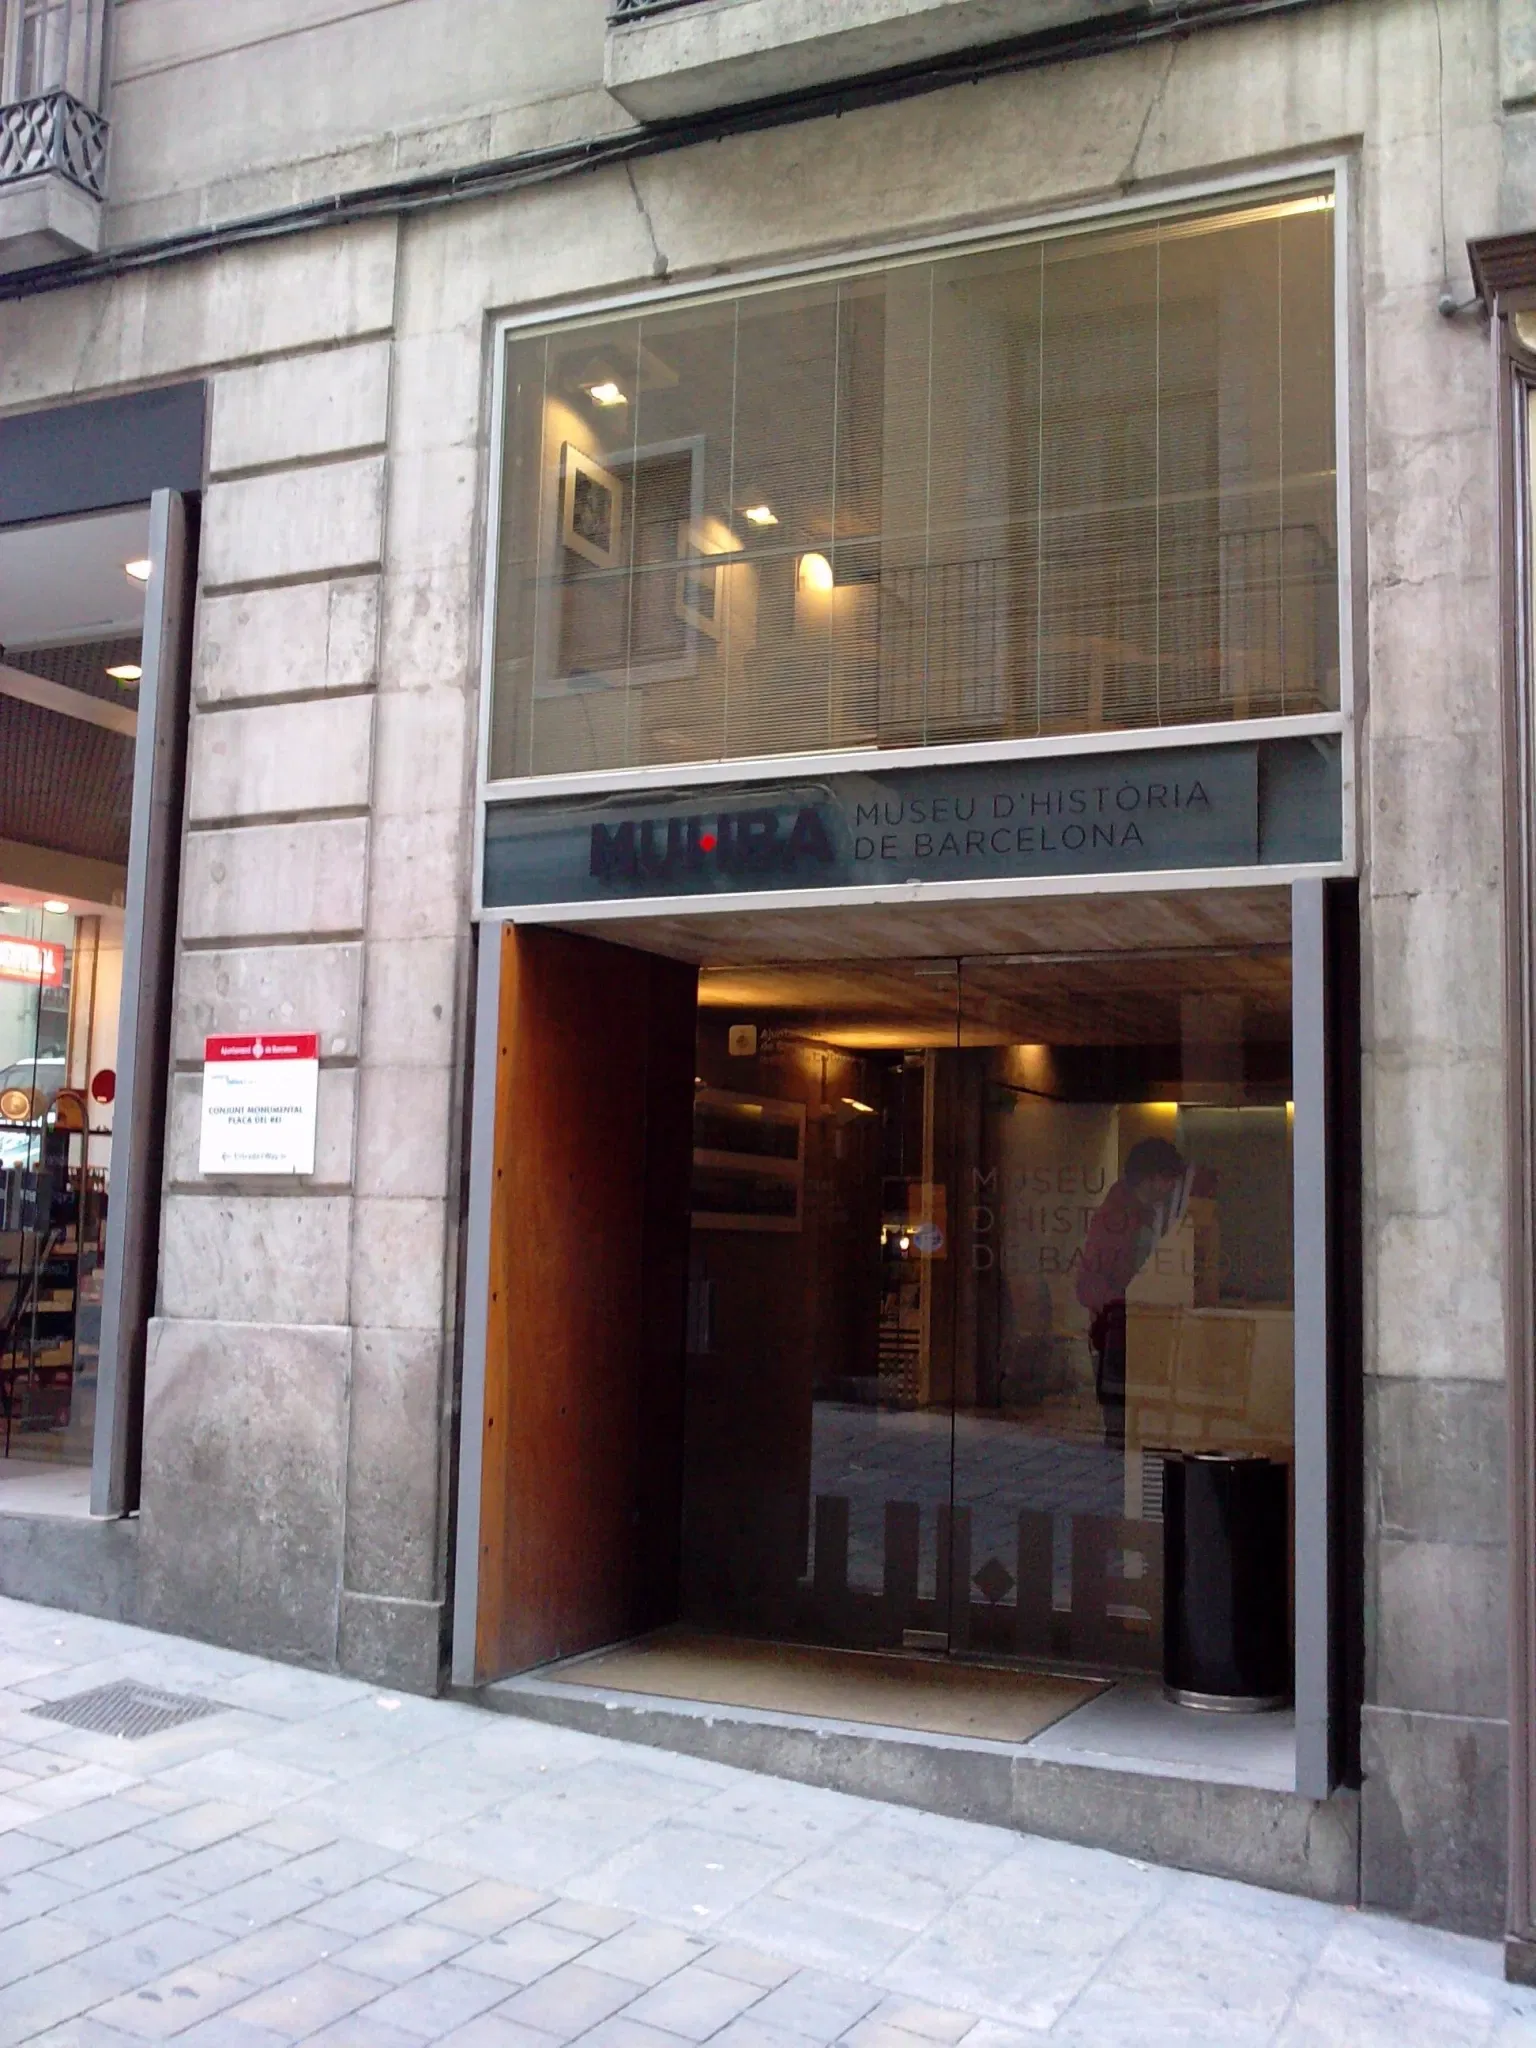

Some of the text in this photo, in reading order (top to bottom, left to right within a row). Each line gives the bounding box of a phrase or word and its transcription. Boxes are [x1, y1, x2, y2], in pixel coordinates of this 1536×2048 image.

[855, 780, 1211, 827] MUSEU D'HISTÒRIA
[854, 822, 1144, 861] DE BARCELONA
